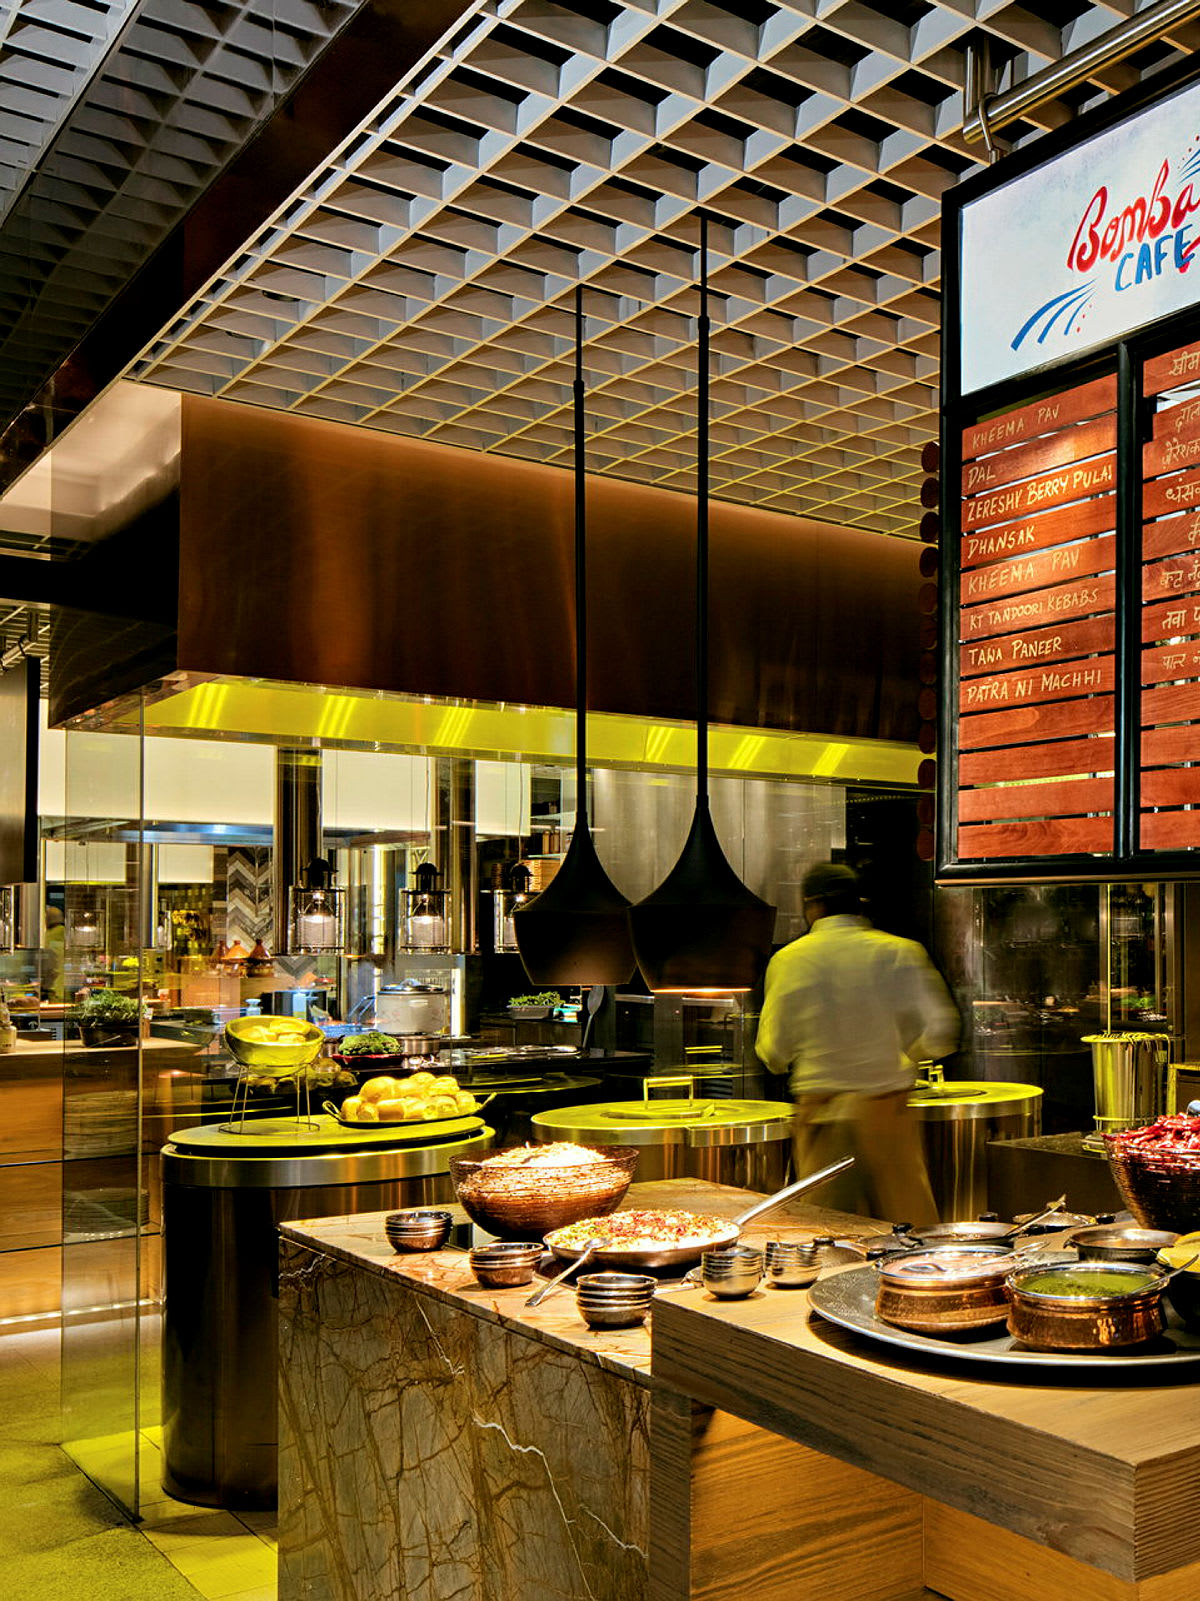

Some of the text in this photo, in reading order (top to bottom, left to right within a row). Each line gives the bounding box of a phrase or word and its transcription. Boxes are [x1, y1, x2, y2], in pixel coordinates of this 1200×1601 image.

[1114, 223, 1195, 292] CAFE
[972, 404, 1060, 449] KHEEMA PAV
[967, 465, 996, 489] DAL
[1026, 475, 1069, 506] BERRY
[967, 525, 1035, 560] DHANSAK
[968, 548, 1080, 595] KHEEMA PAV
[988, 602, 1043, 624] TANDOORI
[1047, 588, 1099, 611] KEBABS
[1161, 609, 1187, 630] तवा
[968, 636, 1062, 666] TAWA PANEER
[967, 669, 1101, 704] PATRA NI MACHHI
